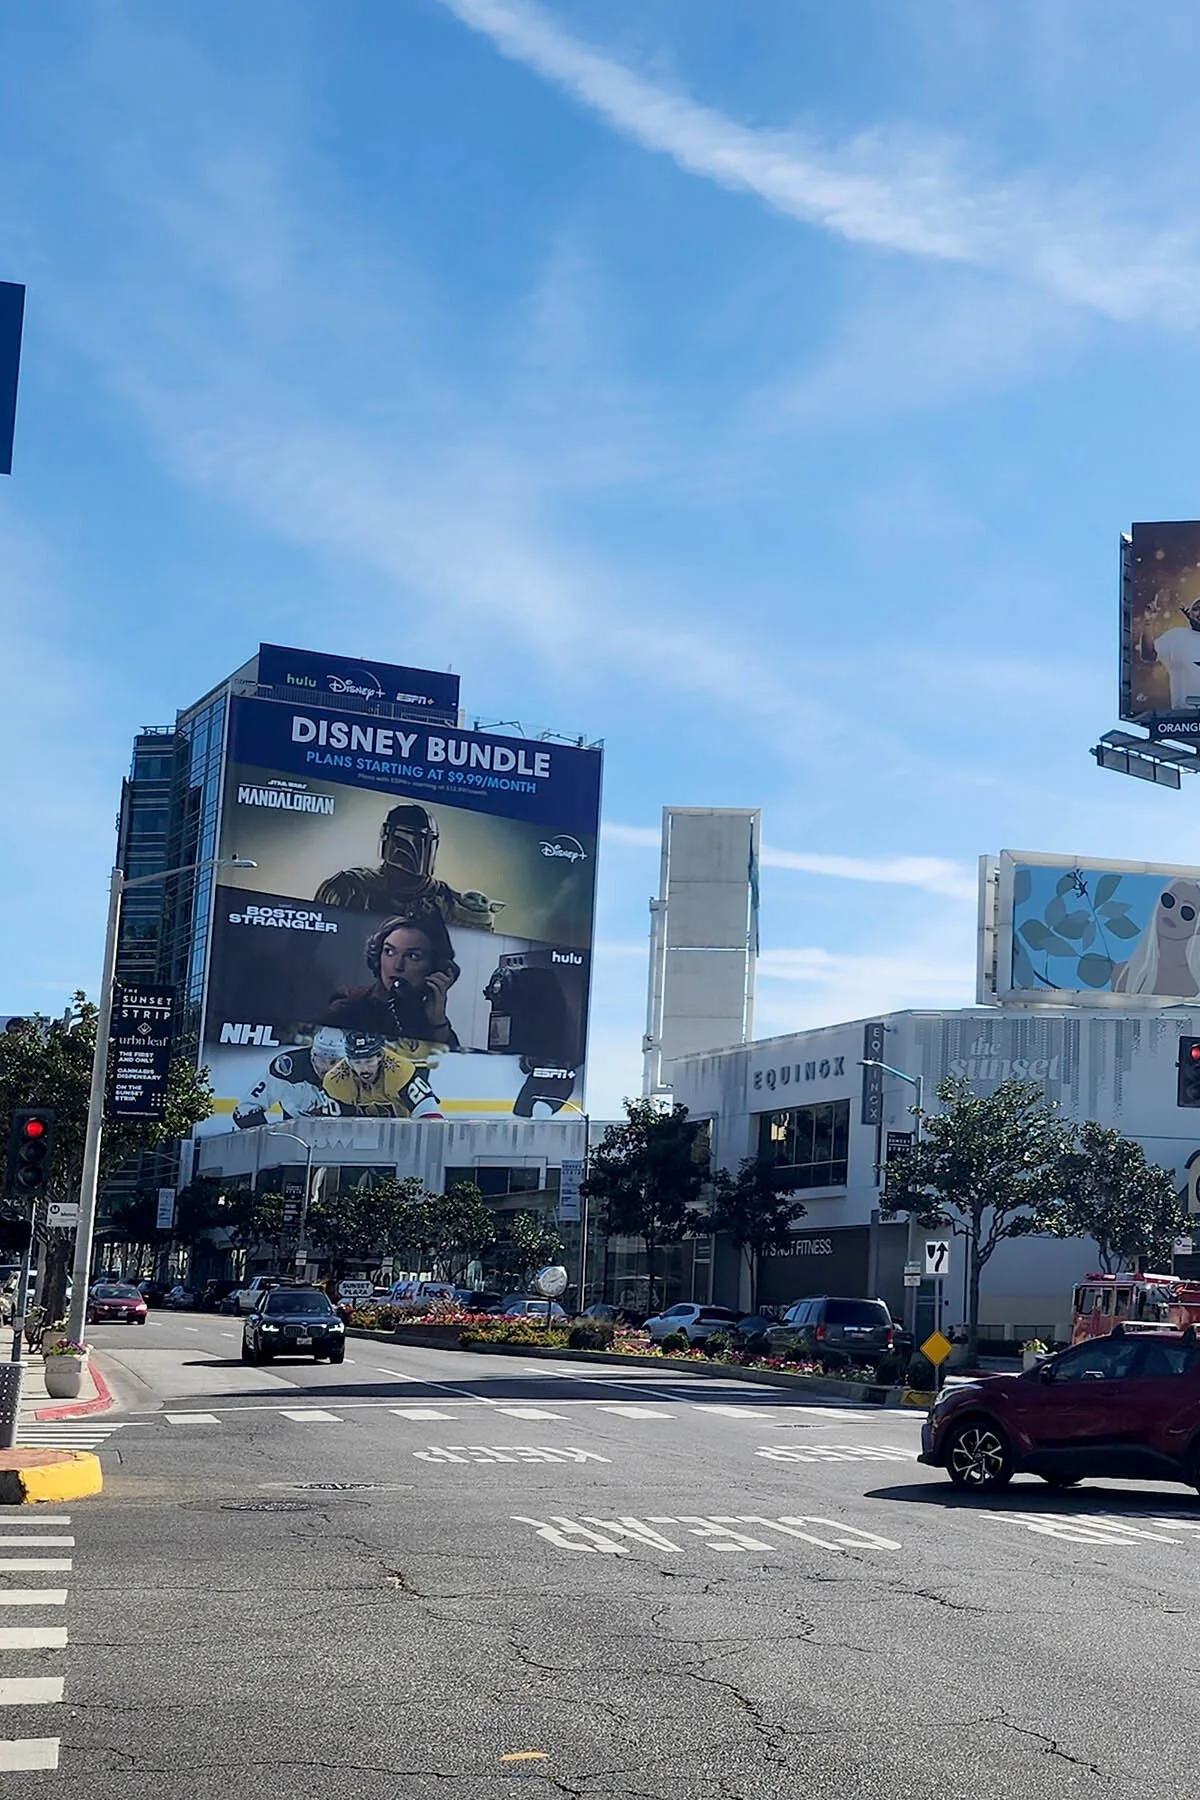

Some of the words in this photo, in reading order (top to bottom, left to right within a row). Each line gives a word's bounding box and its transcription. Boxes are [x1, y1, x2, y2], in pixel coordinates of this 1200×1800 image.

[287, 673, 317, 688] hulu
[326, 670, 386, 700] Disney+
[396, 693, 435, 705] ESPN+
[291, 715, 418, 758] DISNEY
[427, 736, 551, 778] BUNDLE
[306, 751, 352, 768] PLANS
[356, 758, 424, 778] STARTING
[427, 769, 443, 781] AT
[447, 771, 537, 794] $9.99/MONTH
[238, 786, 335, 815] MANDALORIAN
[539, 836, 588, 863] Disney+
[229, 913, 338, 933] STRANGLER
[246, 905, 322, 922] BOSTON
[552, 950, 582, 964] hulu
[122, 995, 172, 1005] SUNSET
[121, 1009, 171, 1020] STRIP
[220, 1023, 280, 1047] NHL
[971, 1034, 1000, 1055] the
[533, 1067, 576, 1080] ESPN+
[753, 1056, 846, 1091] EQUINOX
[866, 1027, 881, 1119] EQINOX
[949, 1055, 1060, 1081] sunset
[250, 1081, 266, 1098] 2
[408, 1076, 432, 1105] 20
[412, 1446, 613, 1463] KEEP
[510, 1515, 902, 1553] CLEAR
